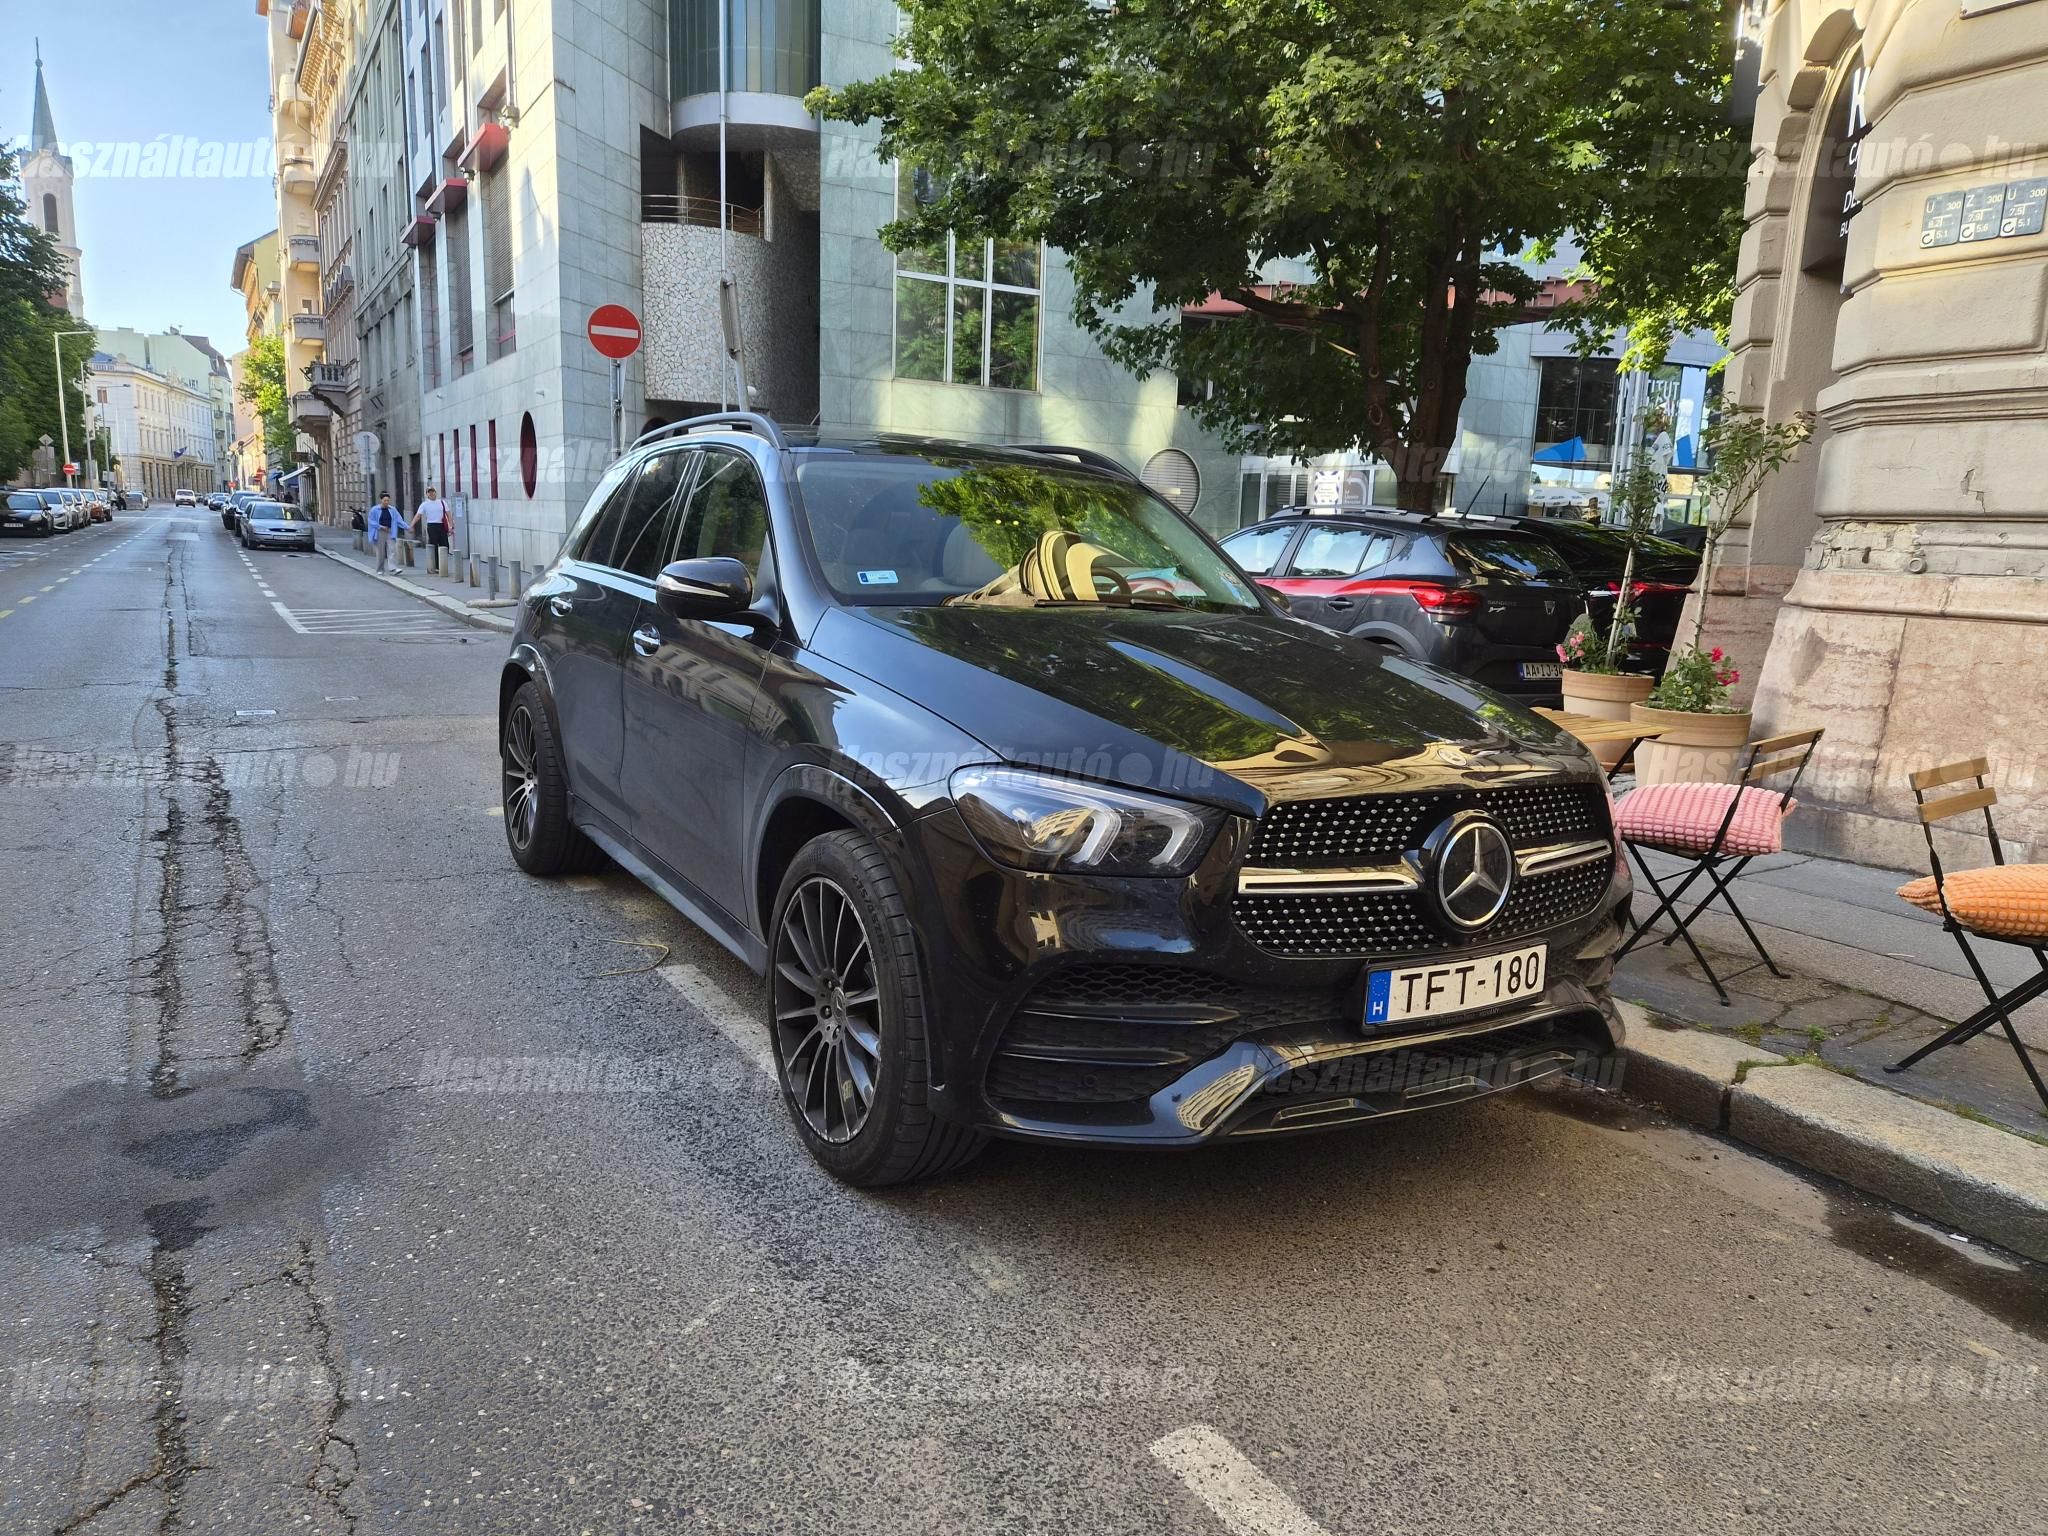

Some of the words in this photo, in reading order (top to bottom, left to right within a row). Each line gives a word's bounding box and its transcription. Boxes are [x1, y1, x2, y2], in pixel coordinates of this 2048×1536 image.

[2029, 187, 2046, 199] 300
[1926, 201, 1935, 214] U
[1945, 200, 1962, 211] 300
[1966, 194, 1975, 208] Z
[1986, 193, 2003, 204] 300
[1372, 1001, 1384, 1016] H
[1400, 951, 1540, 1013] TFT-180
